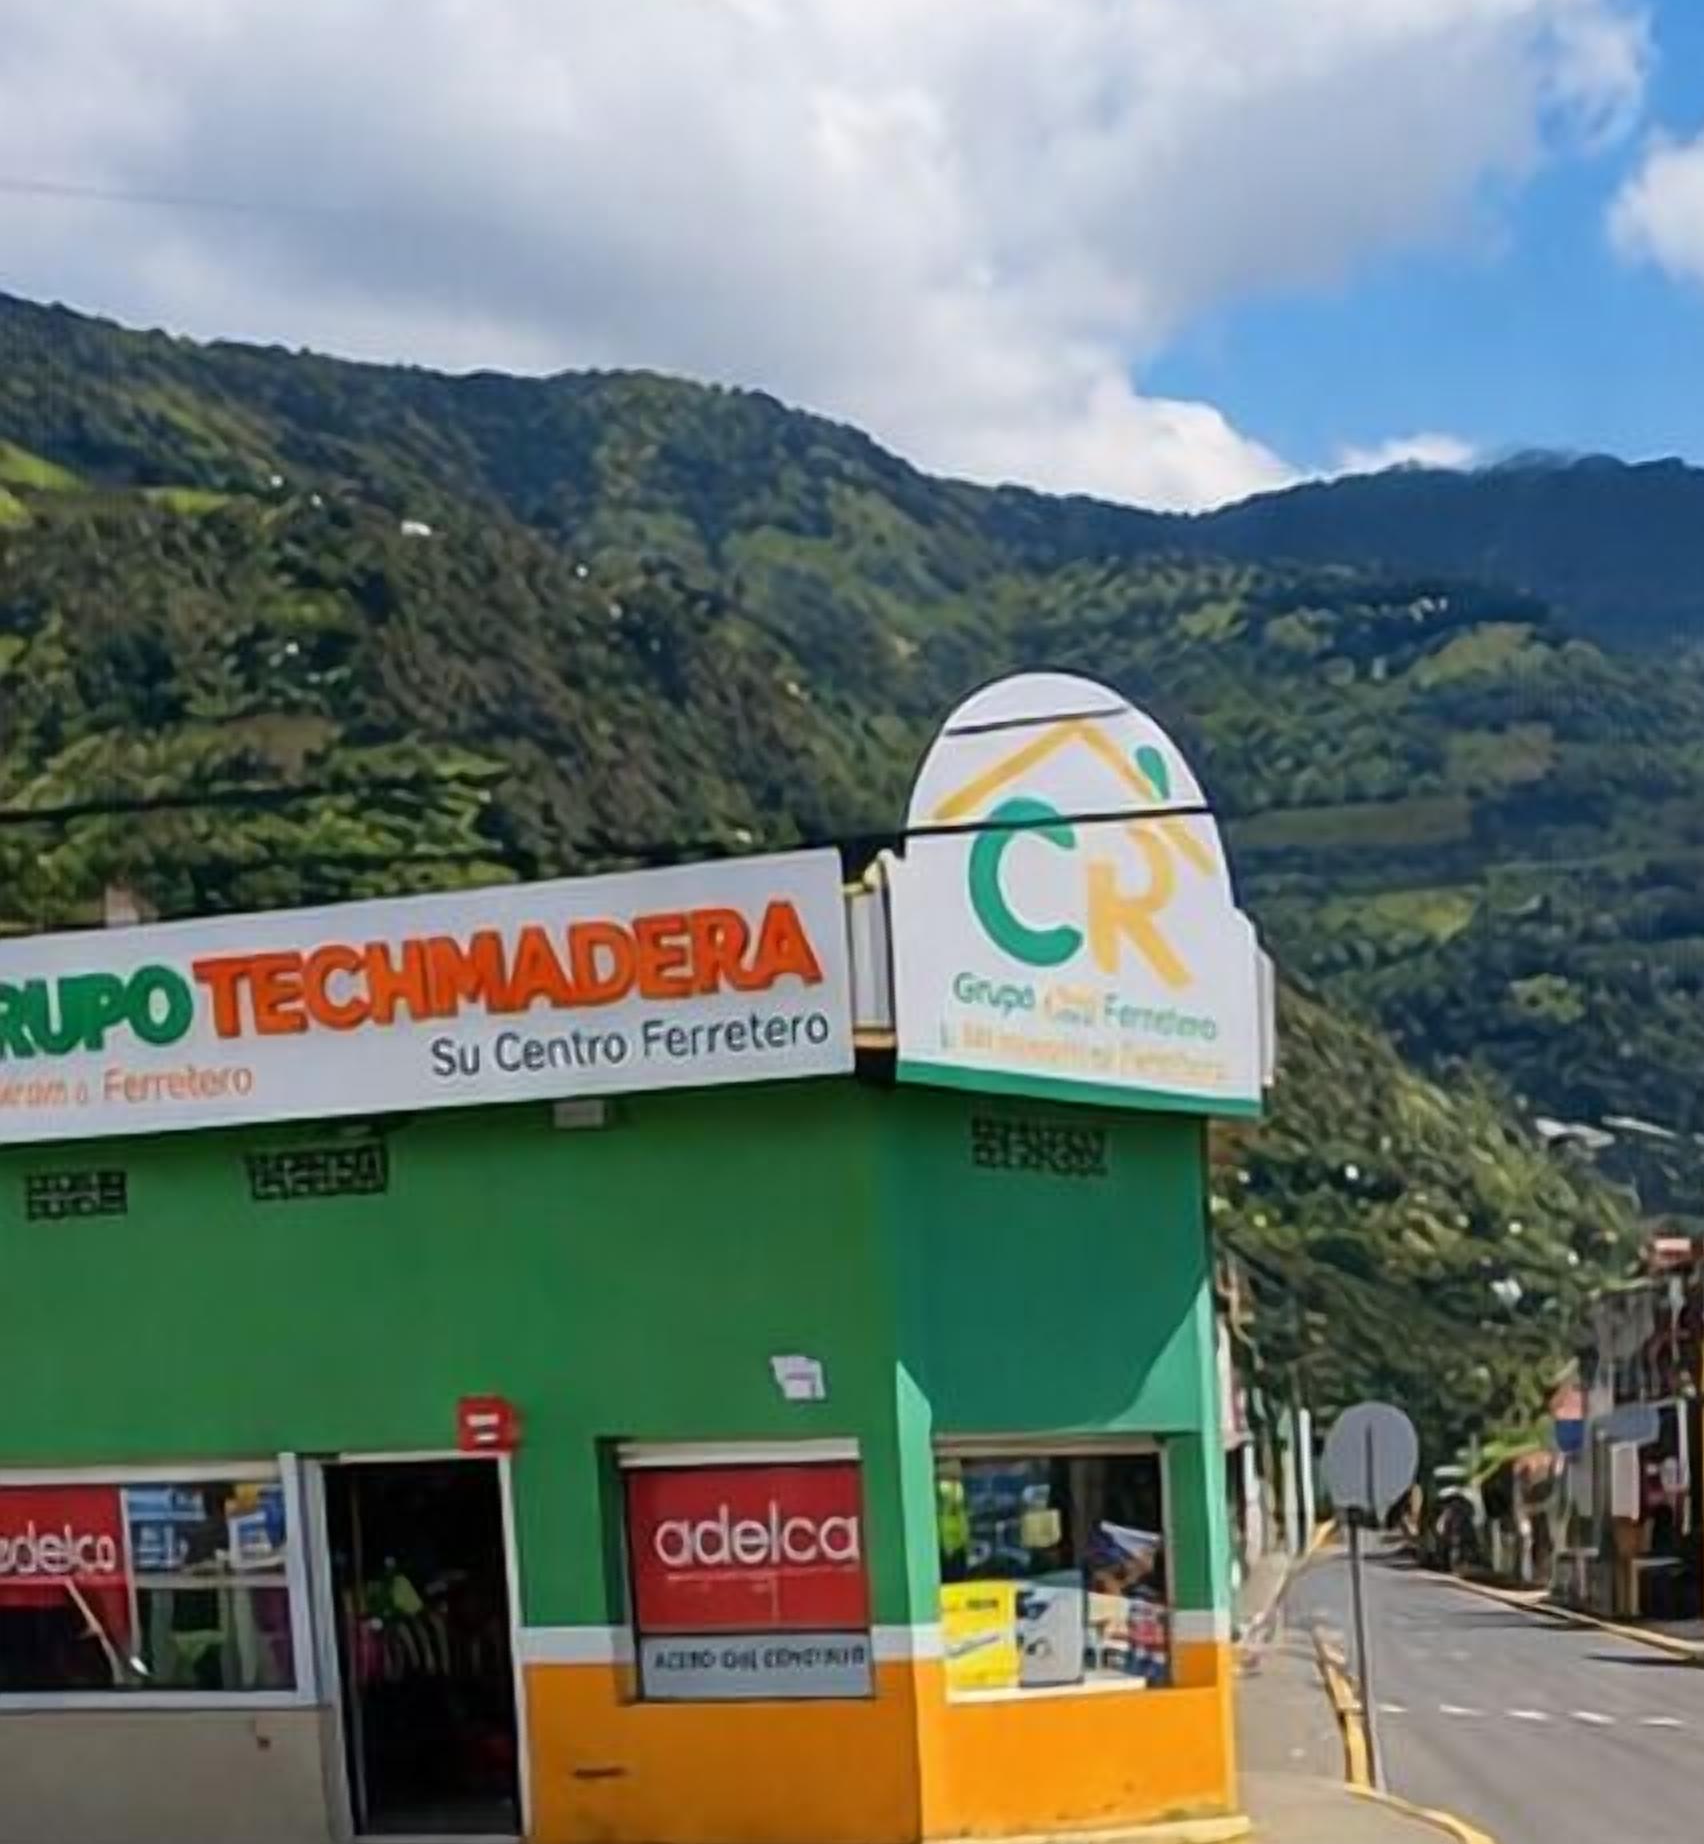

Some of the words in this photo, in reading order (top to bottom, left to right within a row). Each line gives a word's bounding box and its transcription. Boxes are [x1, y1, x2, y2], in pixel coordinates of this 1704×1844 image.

[192, 900, 823, 1039] TECHMADERA
[431, 1037, 480, 1076] Su
[496, 1027, 627, 1072] Centro
[641, 1012, 829, 1057] Ferretero
[655, 1500, 860, 1567] adelca
